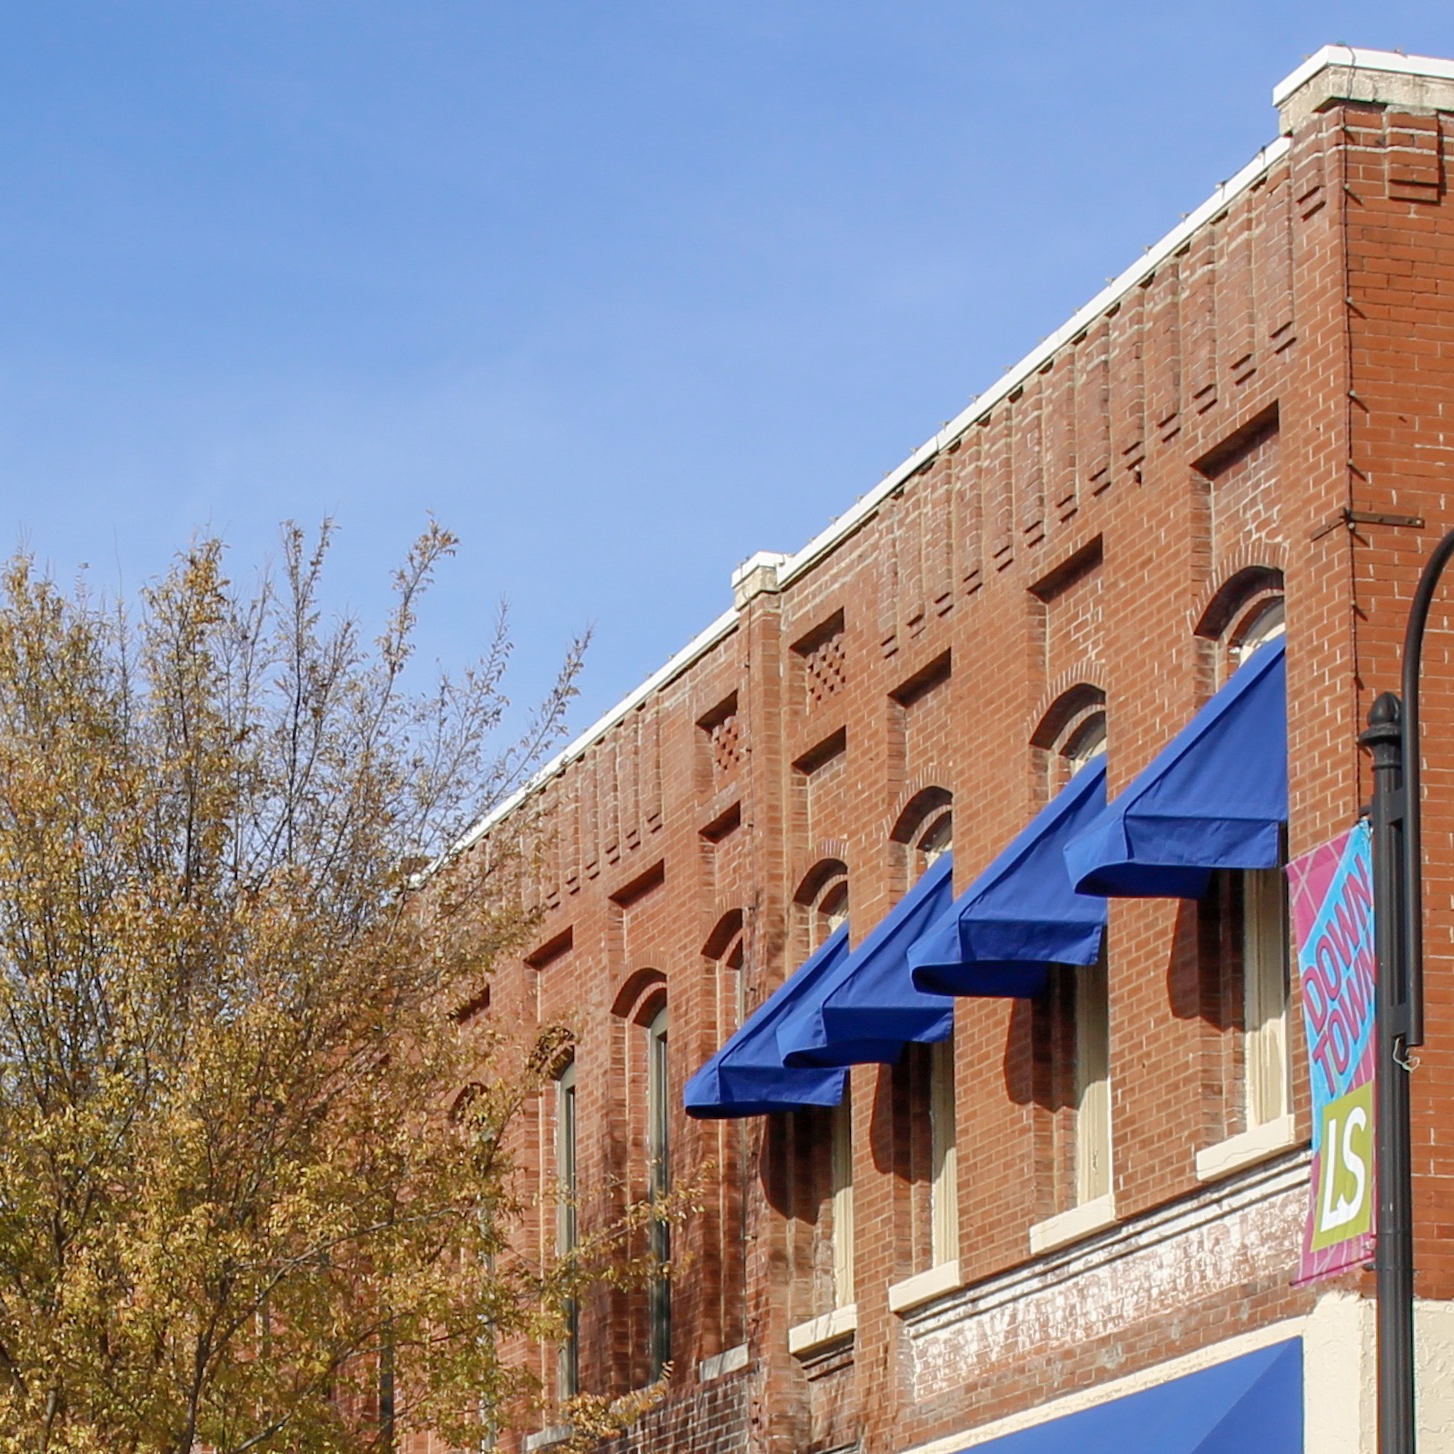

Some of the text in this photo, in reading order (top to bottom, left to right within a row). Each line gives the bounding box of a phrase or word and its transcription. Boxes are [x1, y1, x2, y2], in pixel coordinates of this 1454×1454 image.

[1302, 853, 1374, 1037] DOWN
[1312, 943, 1376, 1096] TOWN
[1320, 1106, 1367, 1233] LS
